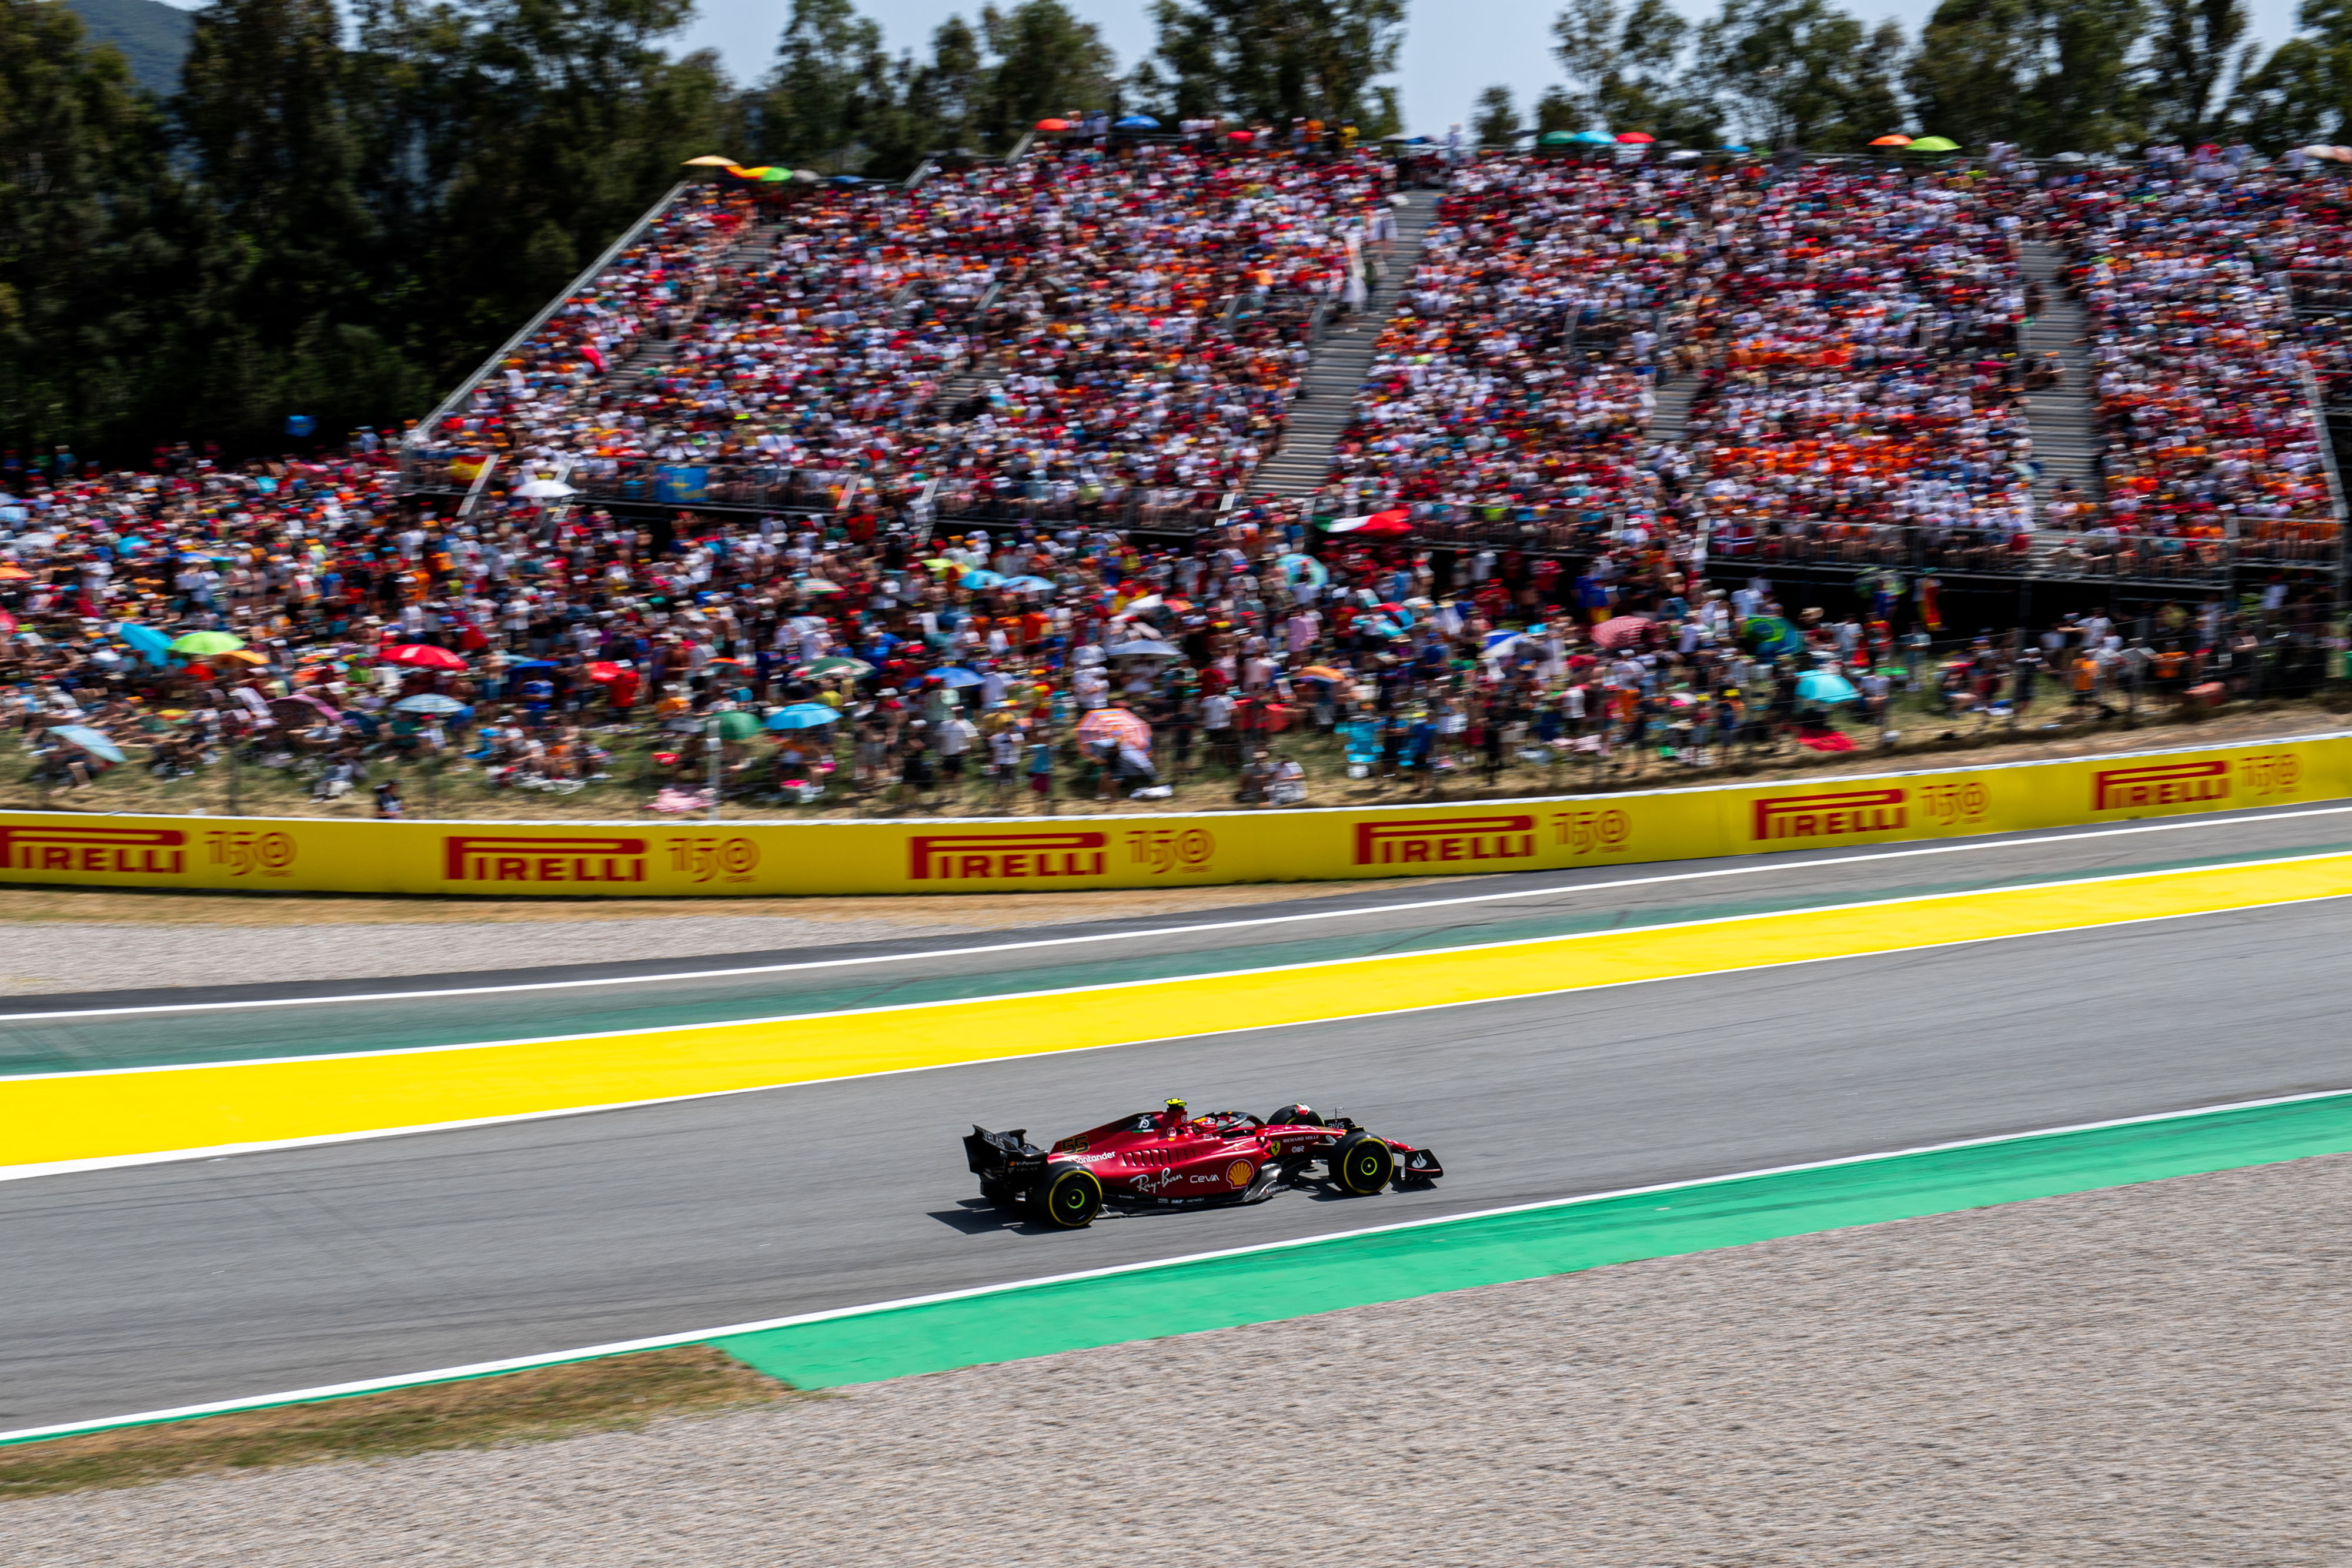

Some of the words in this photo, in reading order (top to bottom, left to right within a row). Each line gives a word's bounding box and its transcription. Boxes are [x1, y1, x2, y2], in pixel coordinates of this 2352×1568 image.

[2091, 760, 2231, 811] PIRELLI
[2239, 753, 2303, 797] 150
[1750, 788, 1910, 841] PIRELLI
[1919, 781, 1990, 827] 150
[0, 825, 188, 874] PIRELLI
[203, 831, 298, 877] 150
[443, 836, 649, 881] PIRELLI
[666, 837, 760, 882] 150
[906, 831, 1110, 880] PIRELLI
[1124, 828, 1216, 874] 150
[1352, 814, 1537, 865] PIRELLI
[1550, 808, 1631, 855] 150
[983, 1129, 1005, 1149] VELAS
[1061, 1135, 1090, 1155] 55
[1073, 1151, 1115, 1164] Santander
[1130, 1168, 1183, 1193] Ray-Ban
